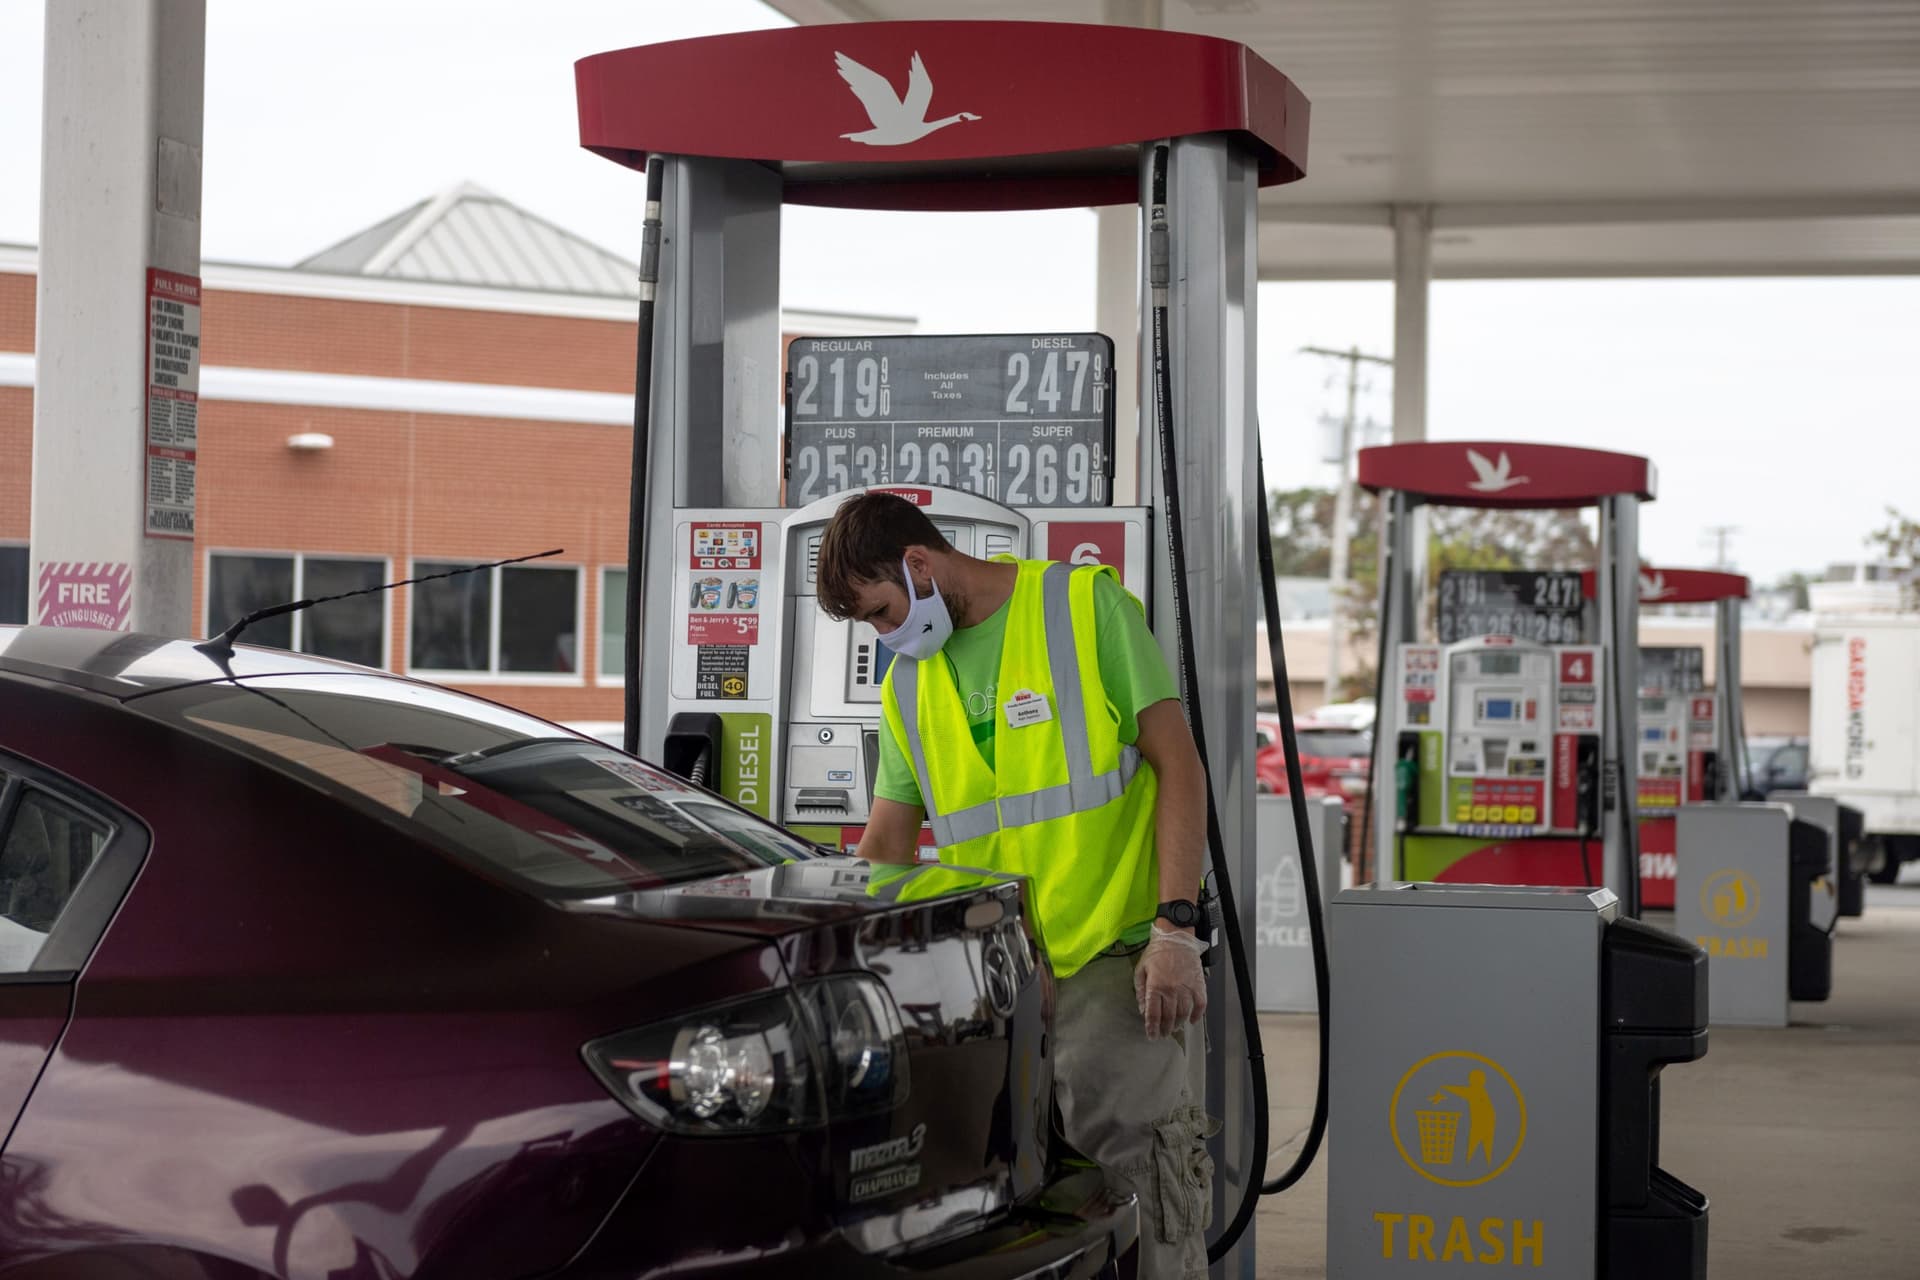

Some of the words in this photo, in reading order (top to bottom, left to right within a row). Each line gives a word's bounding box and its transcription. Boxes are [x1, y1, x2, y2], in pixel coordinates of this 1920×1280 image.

[175, 282, 198, 297] SERVE
[164, 300, 184, 316] SMOKING
[812, 341, 872, 352] REGULAR
[1031, 338, 1075, 349] DIESEL
[924, 371, 969, 380] Includes
[932, 391, 962, 400] Taxes
[825, 427, 856, 439] PLUS
[918, 427, 974, 438] PREMIUM
[1032, 426, 1073, 437] SUPER
[58, 582, 111, 605] FIRE
[52, 607, 116, 632] EXTINGUISHER
[709, 616, 730, 624] Jerry's
[1567, 658, 1585, 680] 4
[697, 682, 719, 690] DIESEL
[725, 682, 743, 691] 40
[738, 725, 760, 805] DIESEL
[1696, 935, 1769, 960] TRASH
[1373, 1211, 1544, 1267] TRASH
